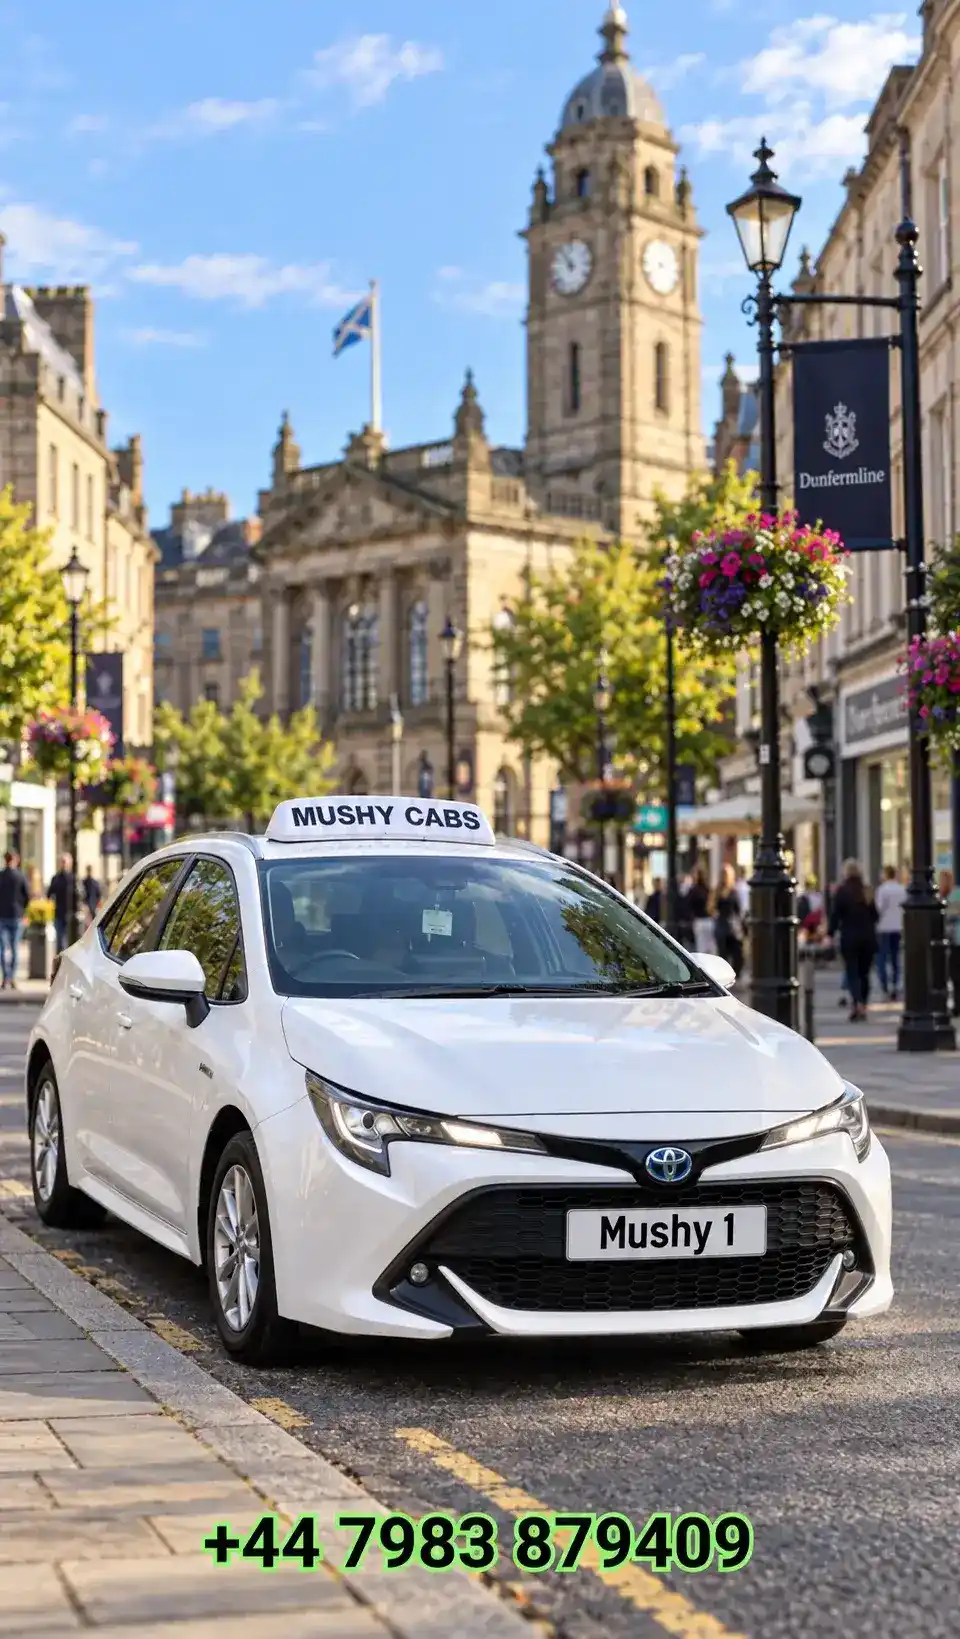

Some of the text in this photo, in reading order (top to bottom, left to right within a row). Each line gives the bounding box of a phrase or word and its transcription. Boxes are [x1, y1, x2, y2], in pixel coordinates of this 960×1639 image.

[799, 467, 885, 489] Dunfermline
[291, 805, 481, 830] MUSHY CABS
[600, 1212, 734, 1255] Mushy 1
